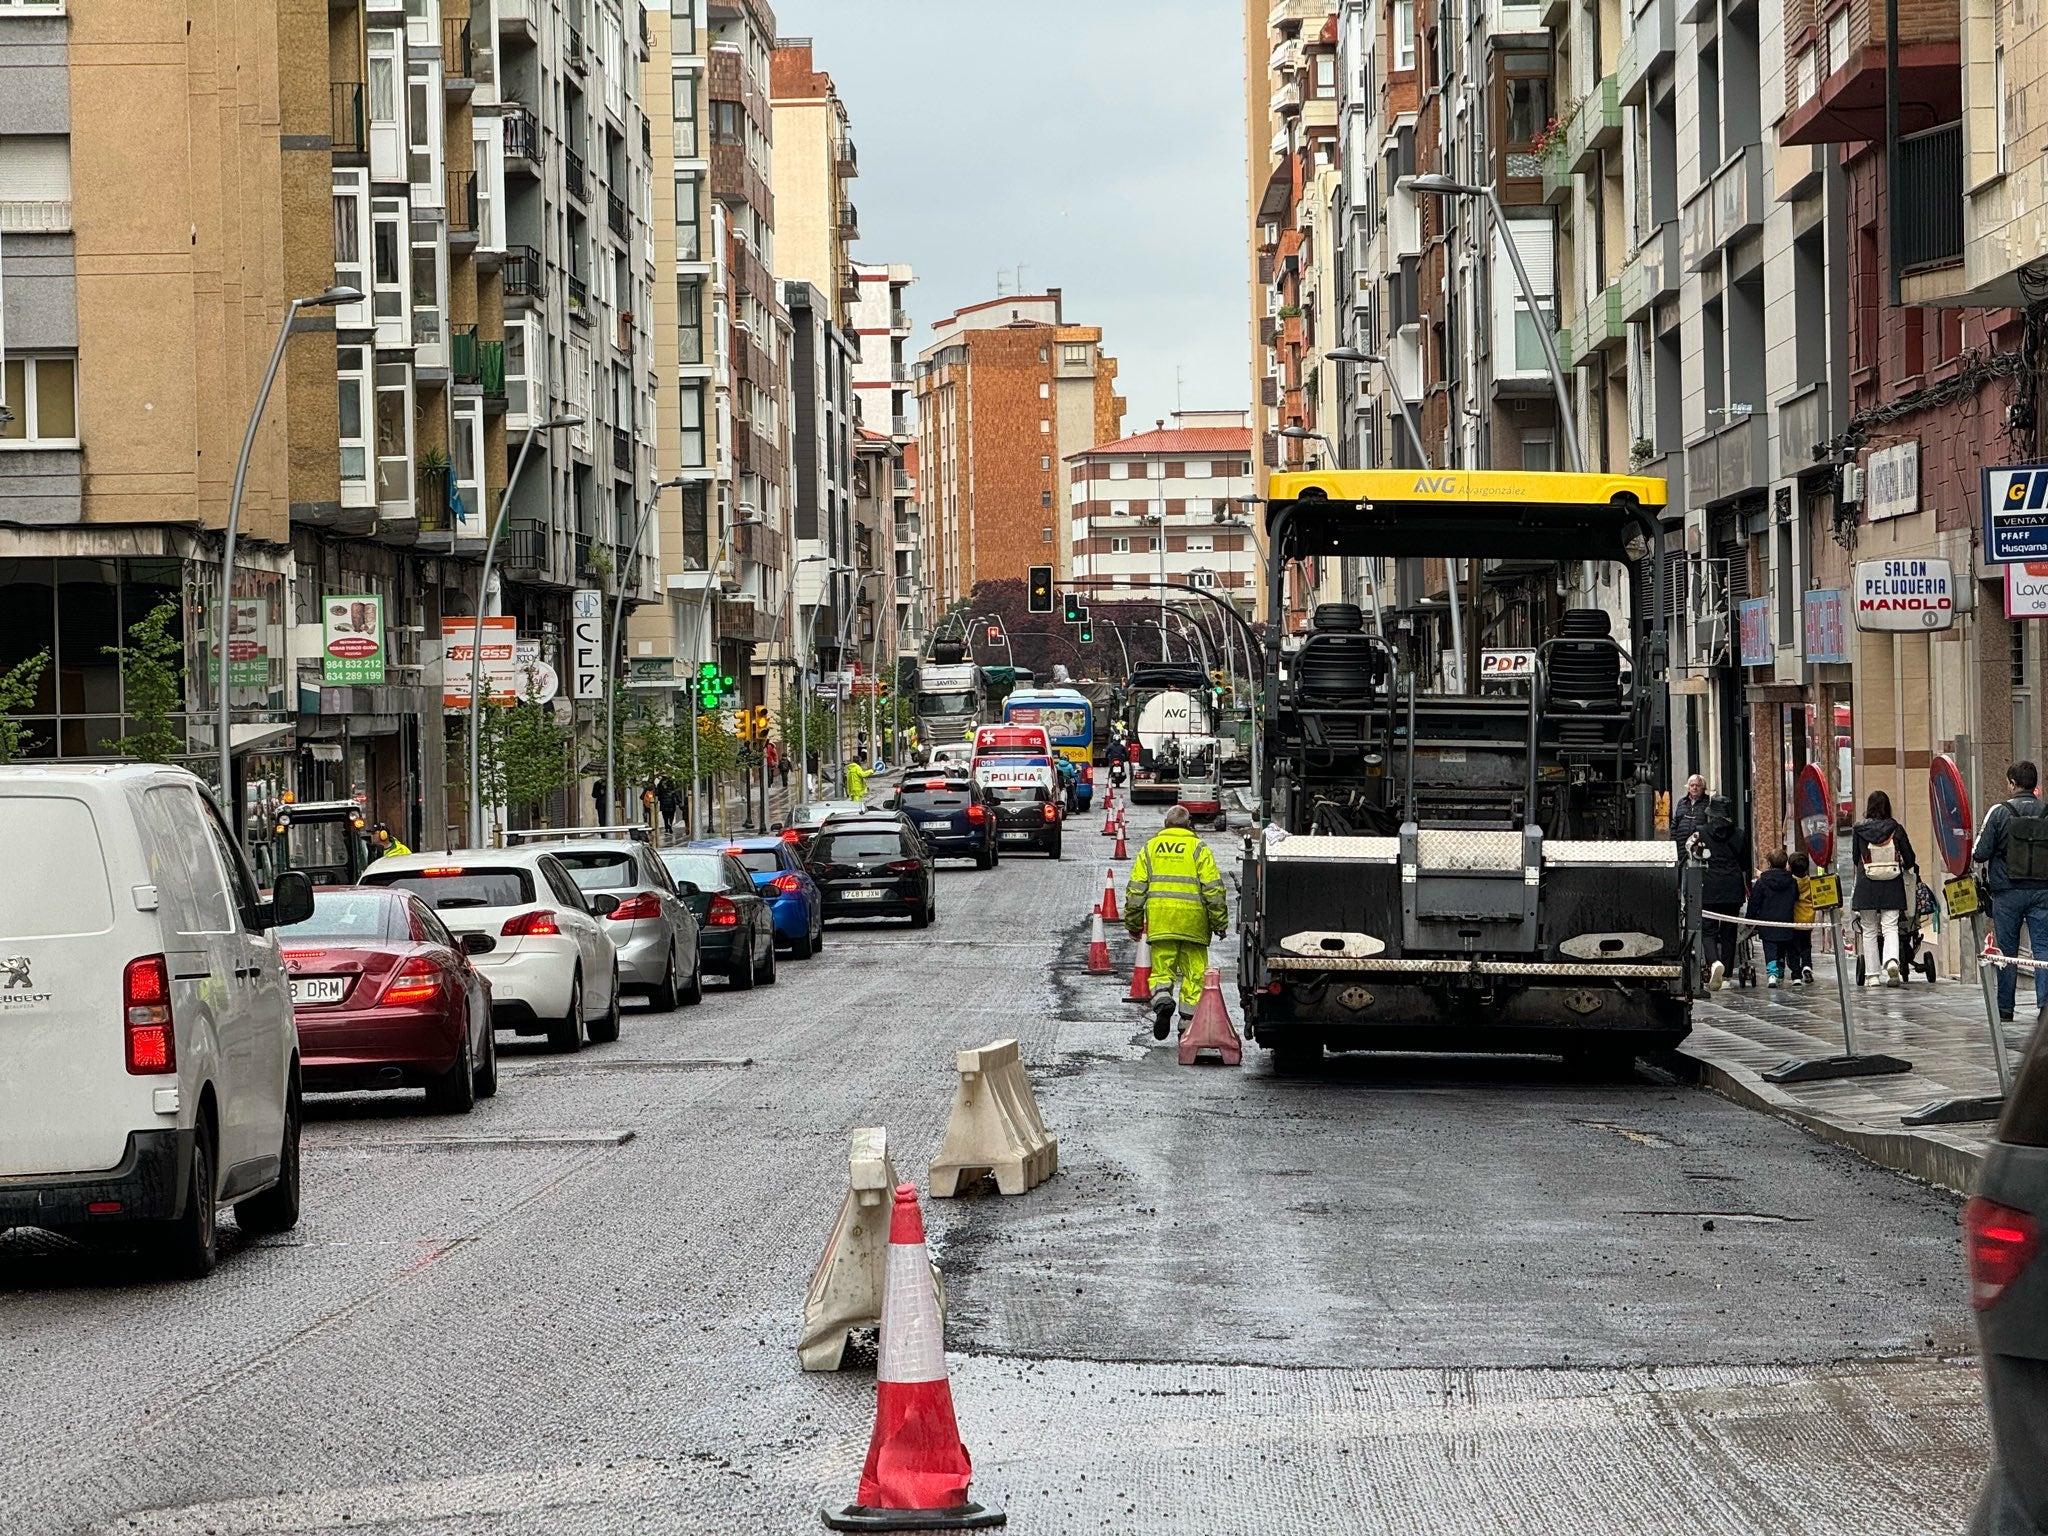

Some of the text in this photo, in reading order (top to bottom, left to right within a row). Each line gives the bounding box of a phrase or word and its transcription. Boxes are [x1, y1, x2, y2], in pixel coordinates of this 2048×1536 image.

[1413, 477, 1456, 494] AVG
[2004, 516, 2046, 525] VENTA Y
[2001, 531, 2030, 540] PFAFF
[2001, 543, 2048, 553] Husqvarna
[1885, 562, 1926, 576] SALON
[1866, 579, 1946, 595] PELUQUERIA
[1860, 598, 1951, 611] MANOLO
[2032, 600, 2047, 609] de
[446, 647, 511, 660] Expess
[326, 660, 381, 669] 984 832 212
[1483, 655, 1527, 671] PDP
[326, 672, 343, 680] 634
[365, 672, 382, 680] 199
[1164, 708, 1187, 718] AVG
[1155, 842, 1187, 854] AVG
[307, 981, 340, 997] DRM
[0, 993, 53, 1003] UGEOT
